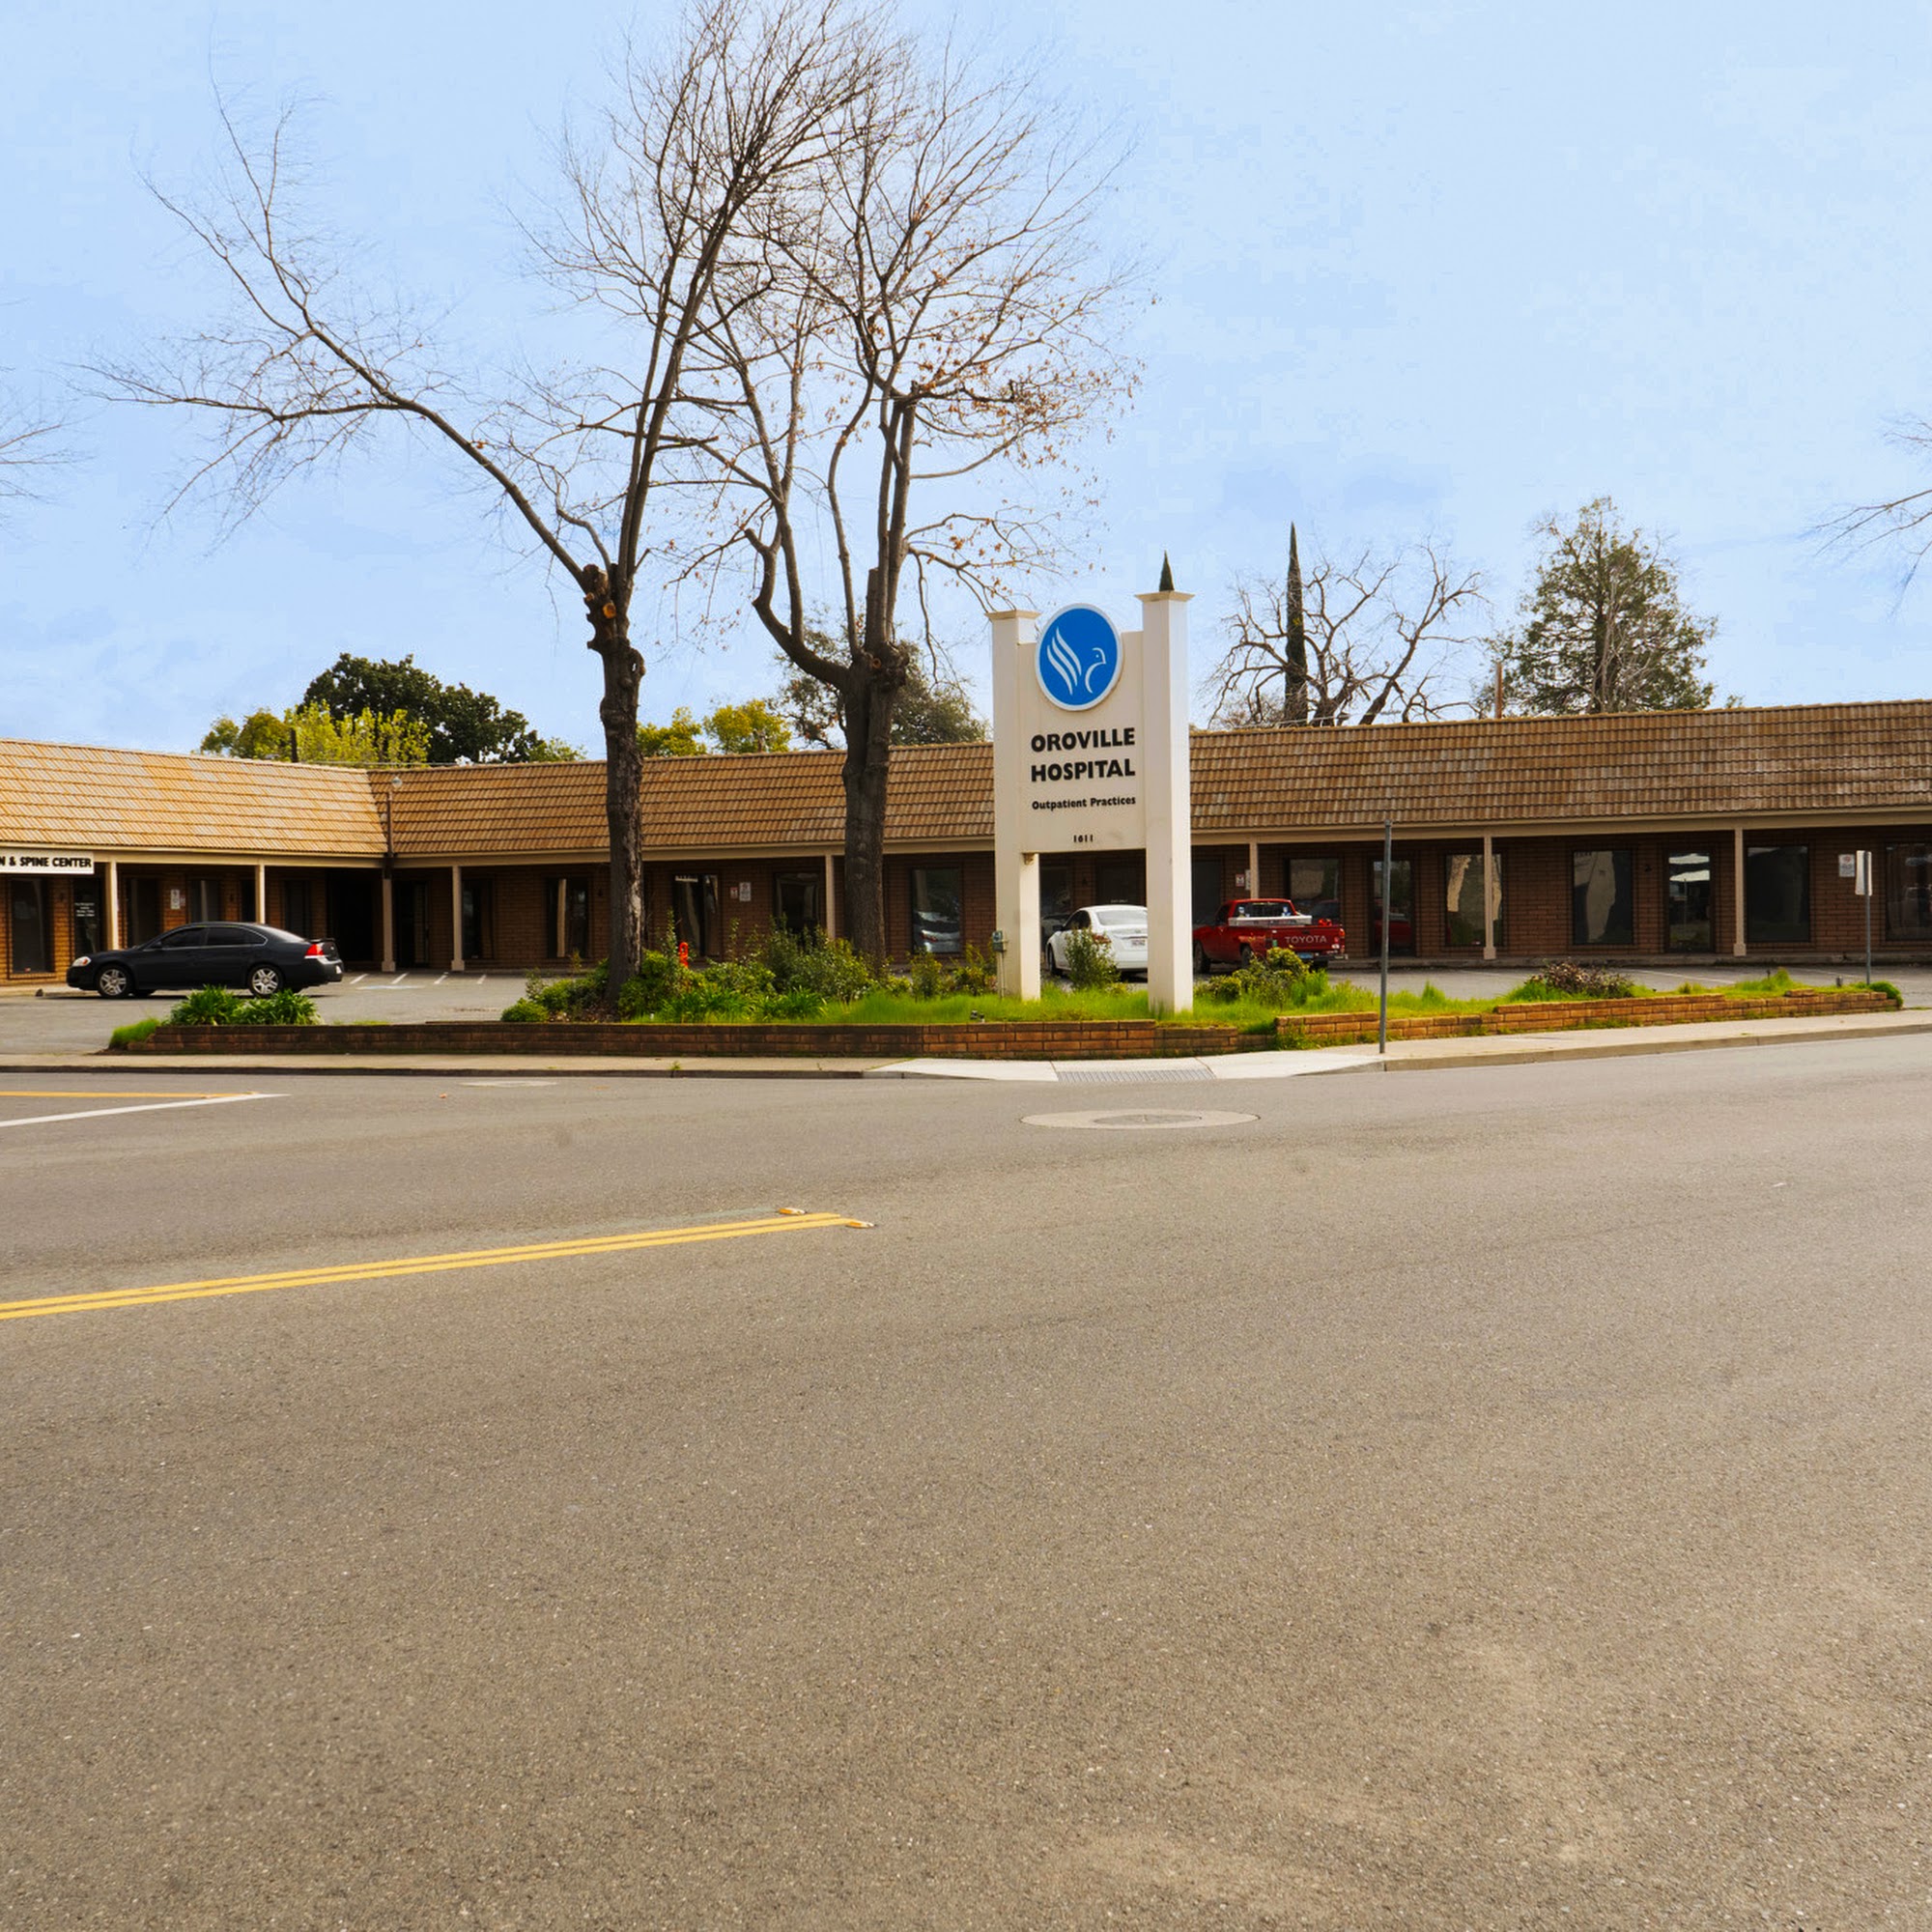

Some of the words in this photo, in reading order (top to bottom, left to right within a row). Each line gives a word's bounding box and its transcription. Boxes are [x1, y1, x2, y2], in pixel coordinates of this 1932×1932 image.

[1031, 727, 1135, 753] OROVILLE
[1031, 758, 1136, 782] HOSPITAL
[1032, 799, 1087, 811] Outpatient
[1091, 796, 1136, 808] Practices
[1073, 834, 1094, 843] 1611
[9, 856, 16, 867] &
[20, 857, 49, 867] SPINE
[52, 857, 92, 868] CENTER
[1285, 935, 1326, 944] TOYOTA
